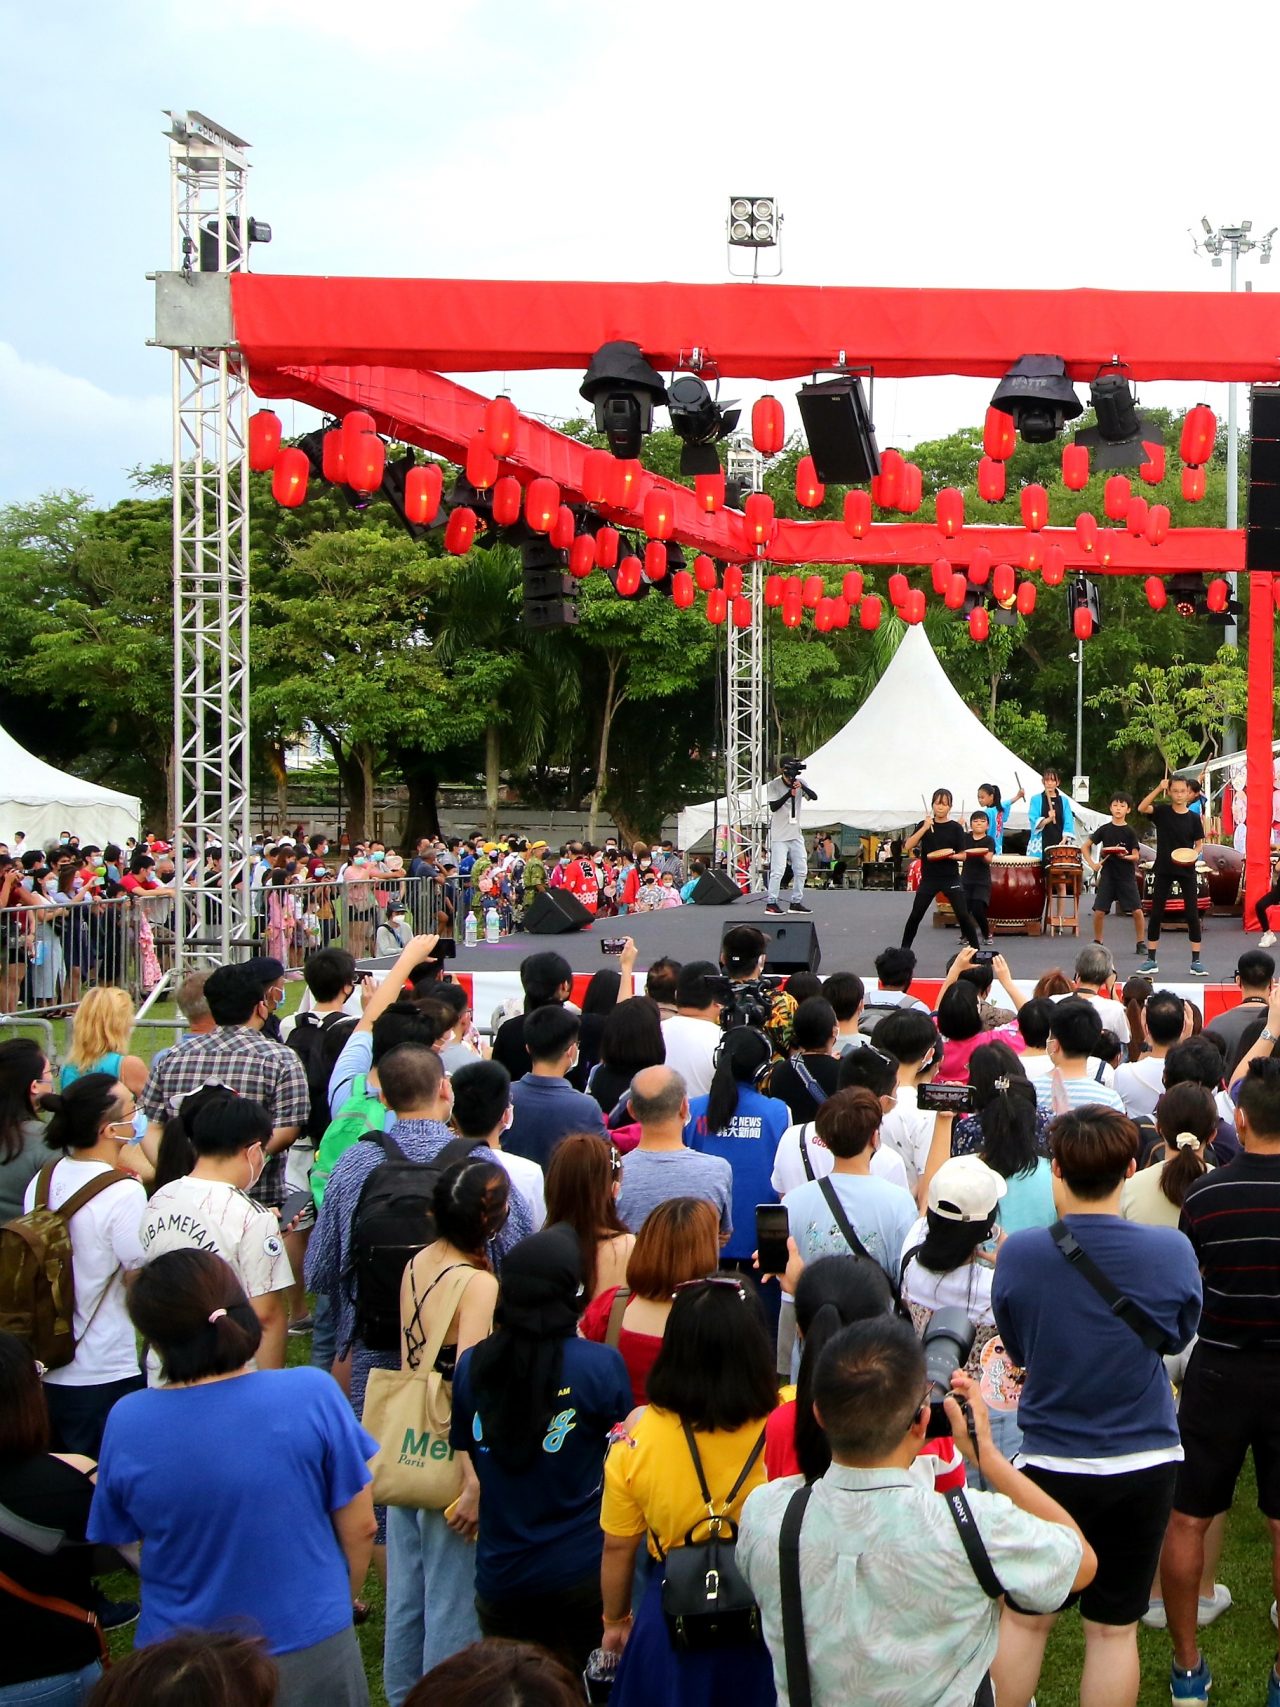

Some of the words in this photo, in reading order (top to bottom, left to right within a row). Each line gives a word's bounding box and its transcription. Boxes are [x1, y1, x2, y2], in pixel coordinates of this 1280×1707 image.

[739, 1116, 761, 1127] NEWS
[143, 1214, 219, 1254] UBAMEYAN
[398, 1454, 425, 1468] Paris
[952, 1496, 968, 1523] SONY
